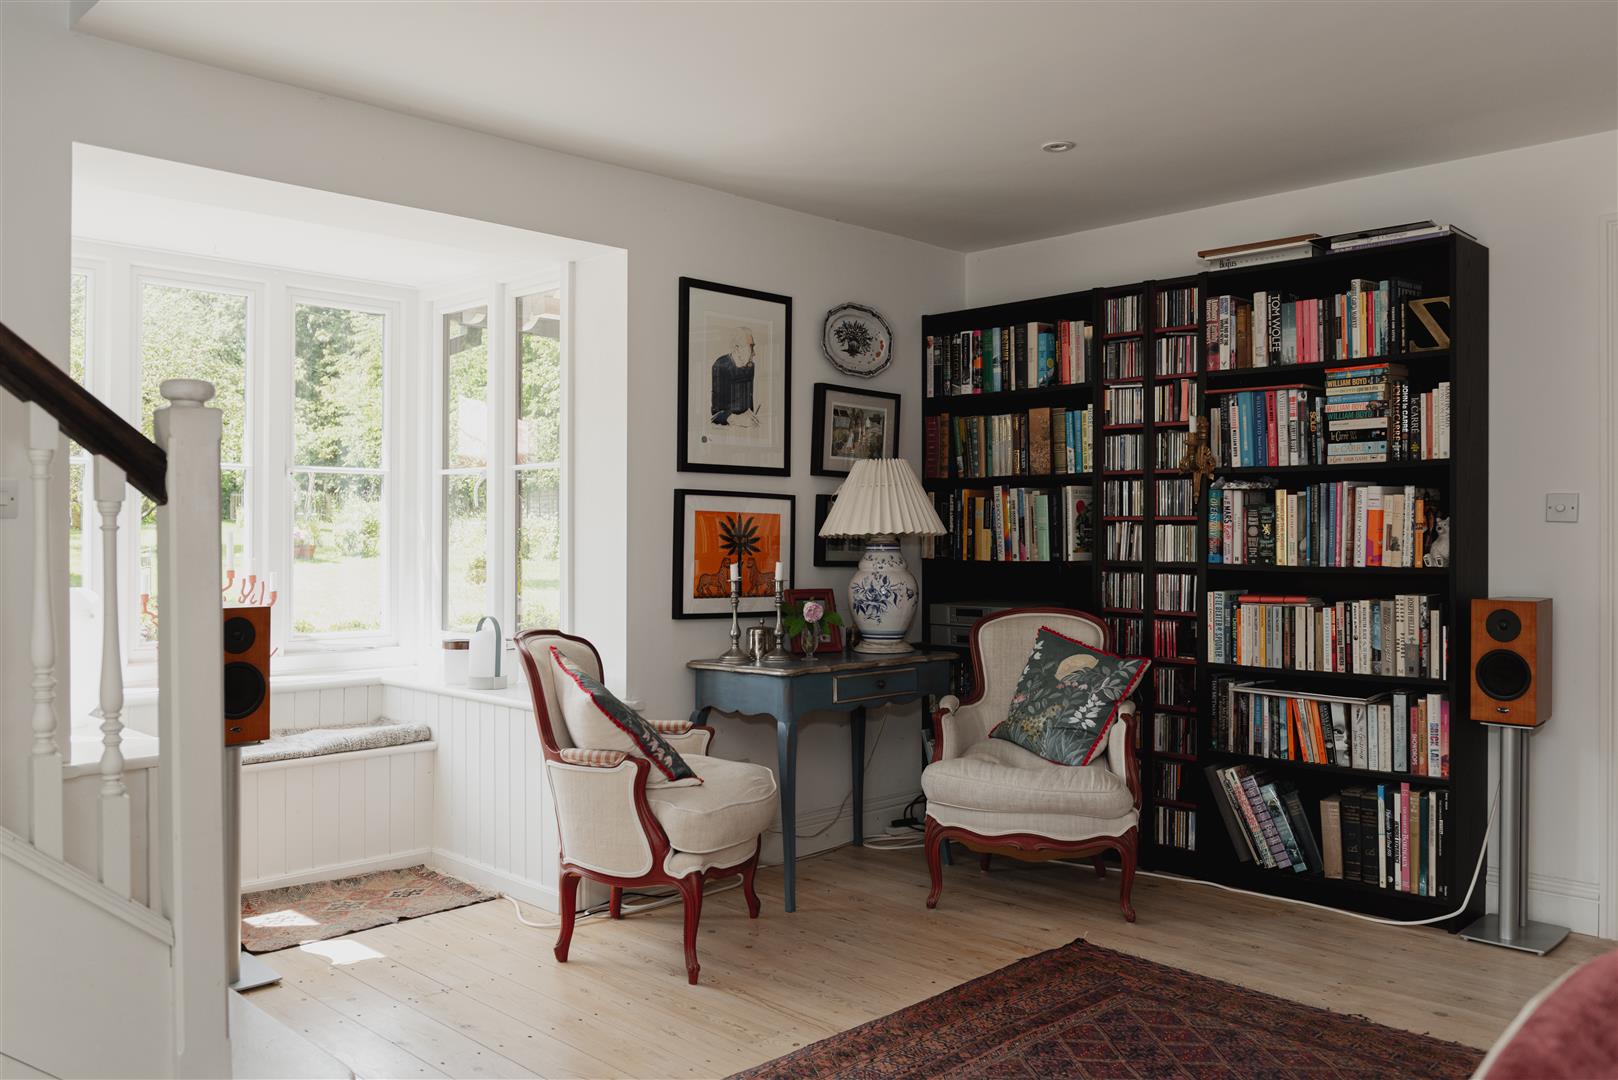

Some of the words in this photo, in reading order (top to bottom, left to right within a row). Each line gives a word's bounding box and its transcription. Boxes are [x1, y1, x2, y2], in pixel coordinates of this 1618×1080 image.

[1272, 294, 1280, 316] TOM
[1272, 318, 1281, 352] WOLFE
[1430, 722, 1440, 746] BRICK
